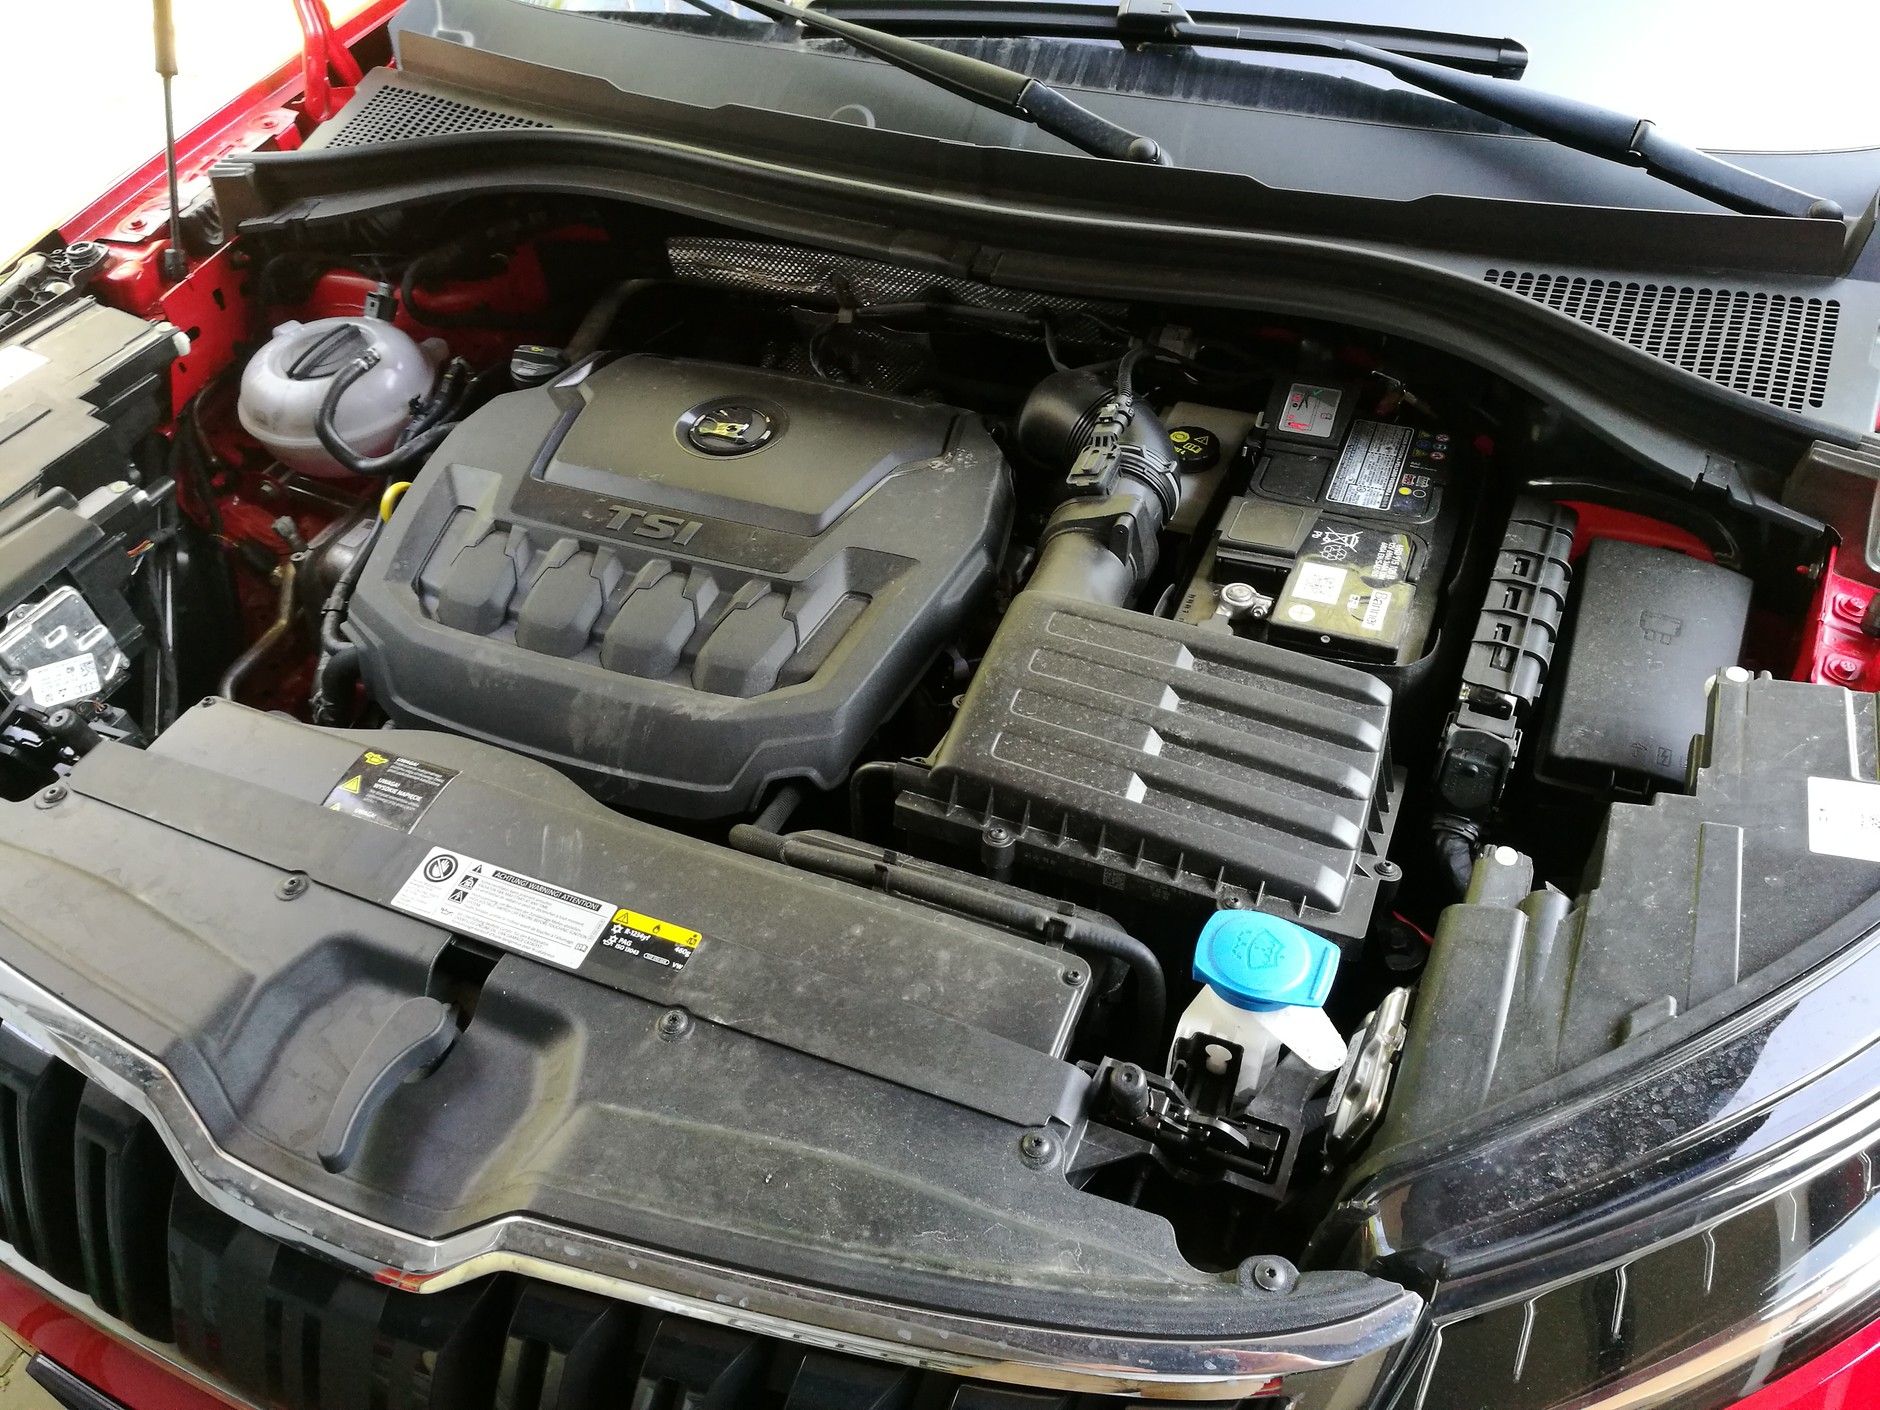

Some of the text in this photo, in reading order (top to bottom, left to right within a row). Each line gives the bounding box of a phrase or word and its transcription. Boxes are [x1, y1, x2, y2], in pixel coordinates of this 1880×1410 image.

[606, 504, 703, 546] TSI
[1366, 592, 1388, 626] Banner
[373, 783, 399, 794] WYSOKIE
[378, 778, 400, 788] UWAGA!
[354, 808, 377, 818] UWAGA!
[495, 871, 598, 909] ACHTUNG! WARNING! ATTENTION!
[624, 928, 652, 942] R-1234yf
[618, 938, 632, 947] PAG
[674, 946, 692, 958] 460g
[672, 961, 684, 970] VW
